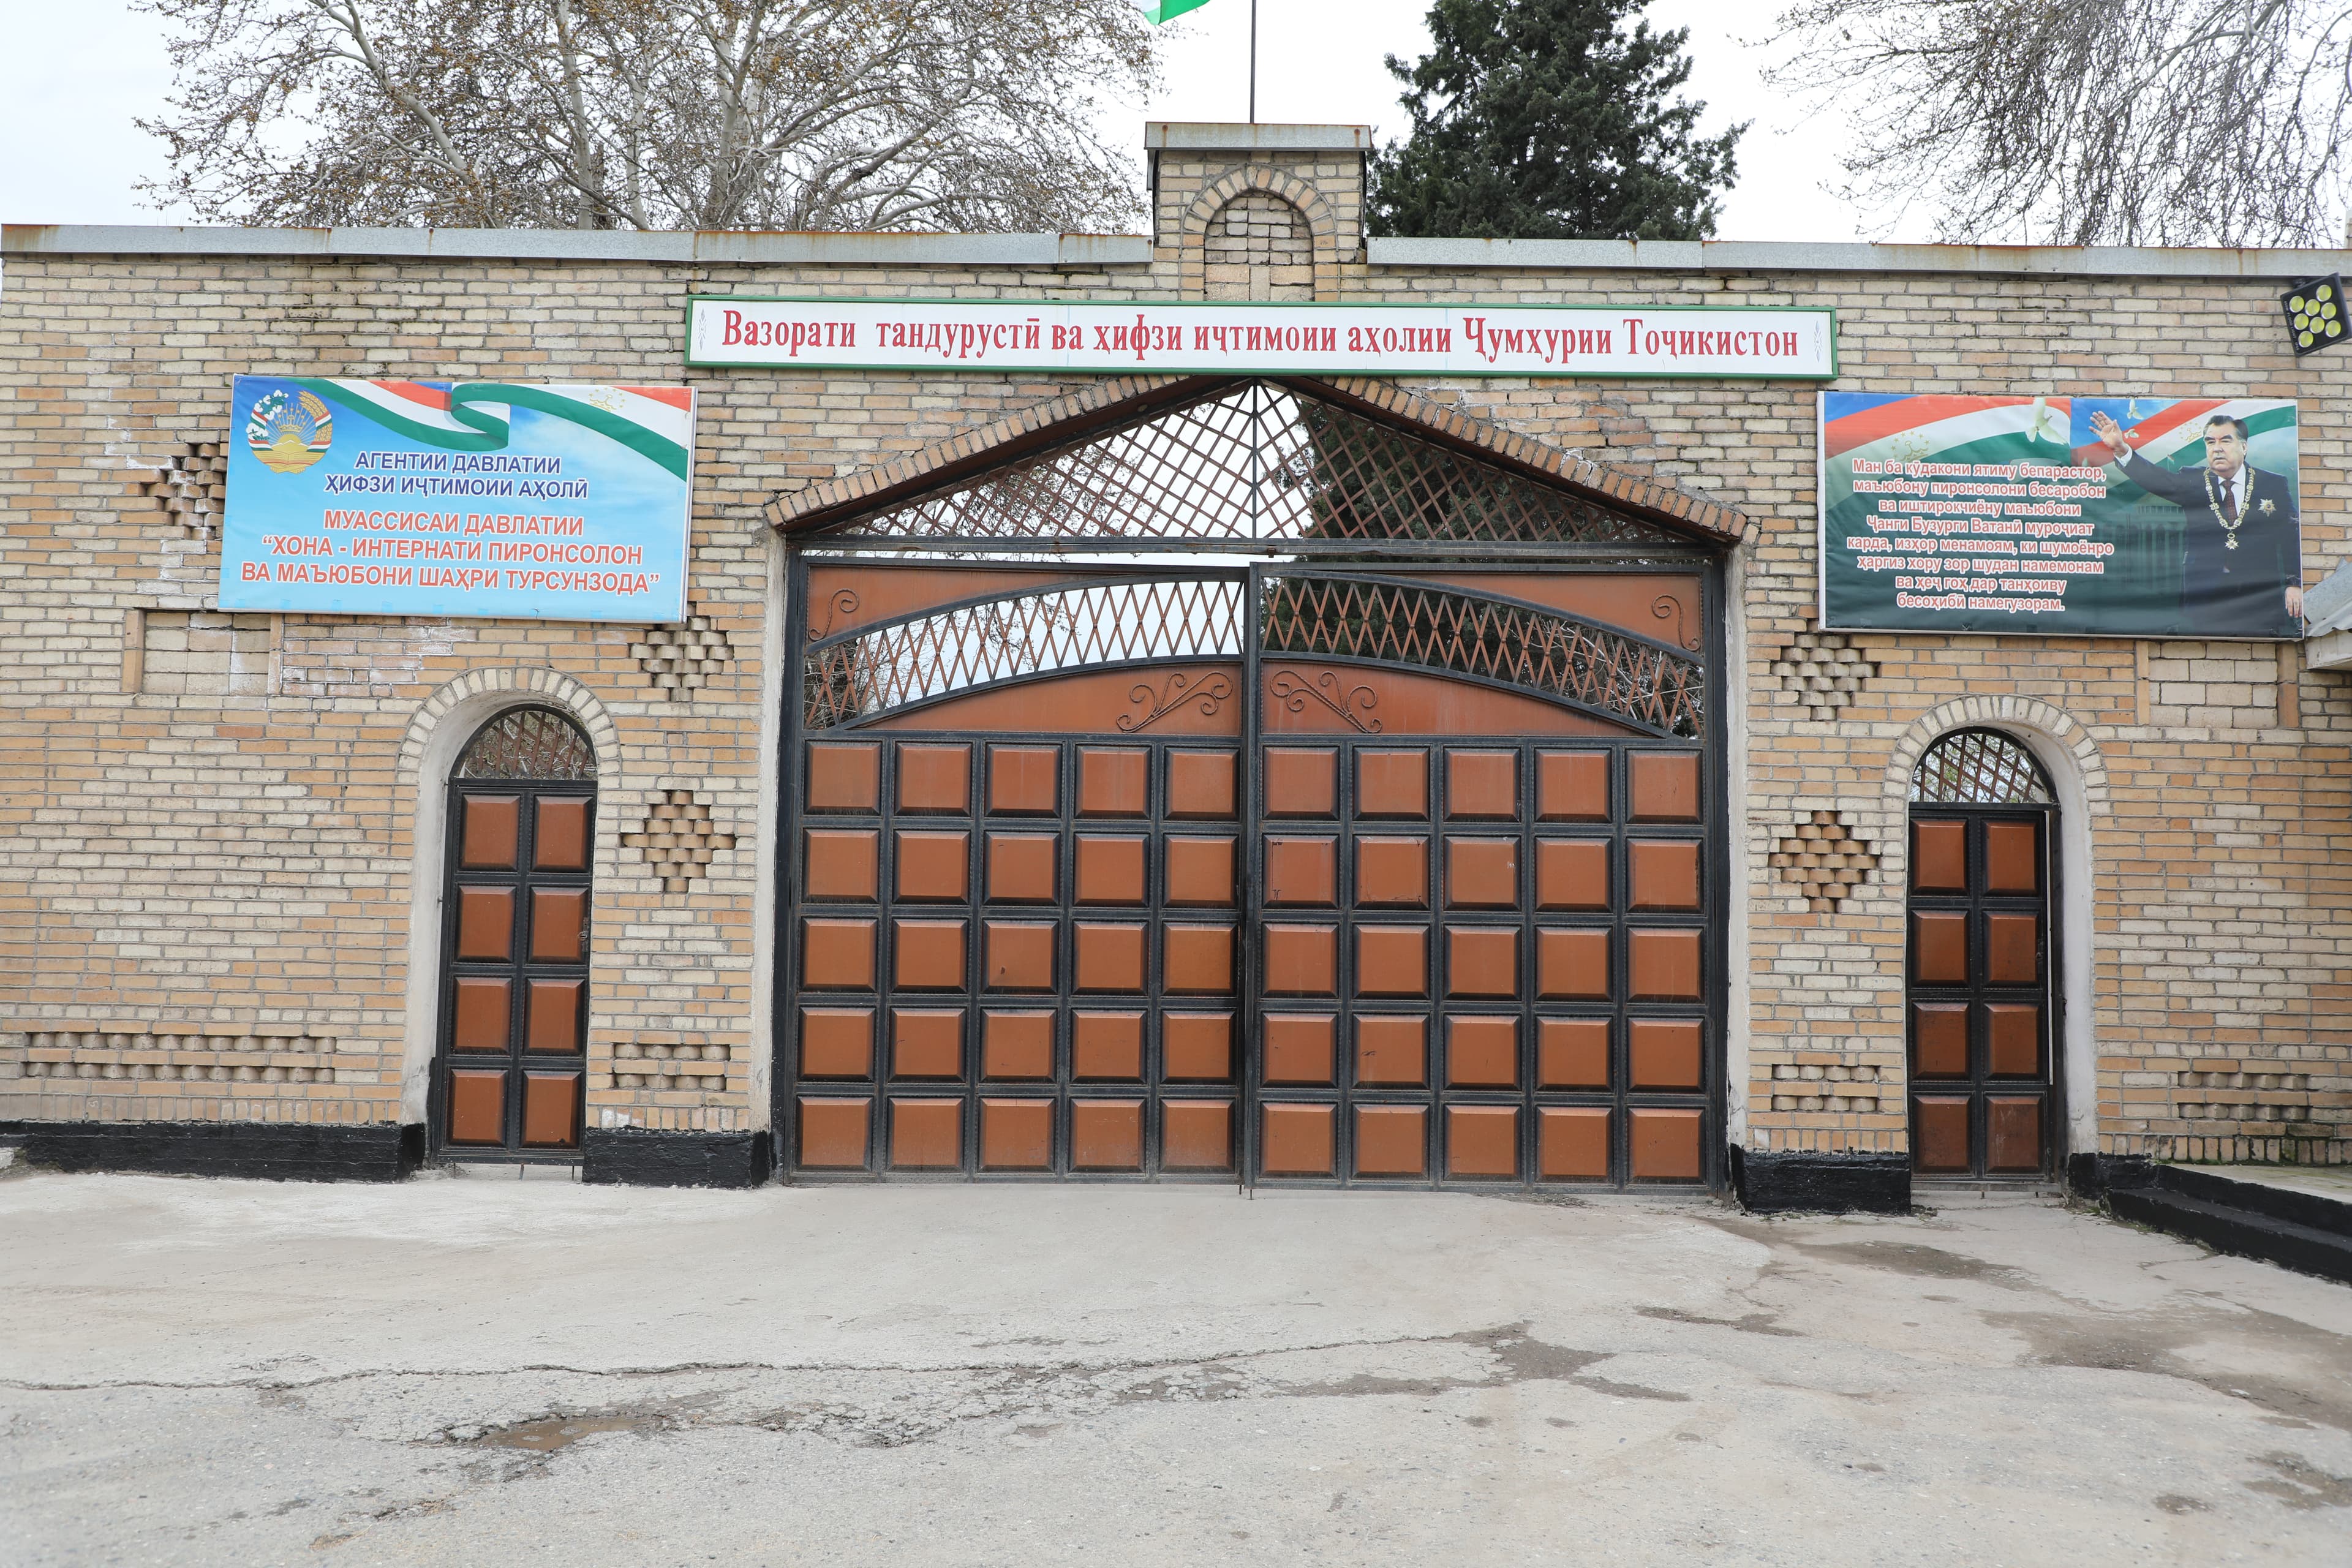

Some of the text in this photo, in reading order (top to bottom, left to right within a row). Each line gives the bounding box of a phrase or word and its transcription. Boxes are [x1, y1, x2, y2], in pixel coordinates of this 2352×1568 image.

[722, 310, 855, 357] Вазорати
[1052, 325, 1084, 350] ва
[356, 452, 560, 474] АГЕНТИИ ДАВЛАТИИ
[1853, 459, 2106, 481] Ман ба кӯдакони ятиму бепарастор,
[326, 475, 587, 500] ҲИФЗИ ИҶТИМОИИ АҲОЛӢ
[1853, 479, 2106, 499] маъюбону пиронсолони бесаробон
[1880, 500, 2081, 518] ва иштирокчиёну маъюбони
[325, 510, 582, 536] МУАССИСАИ ДАВЛАТИИ
[1913, 518, 1968, 537] Бузурги
[1972, 519, 2022, 534] Ватанӣ
[353, 538, 481, 560] ИНТЕРНАТИ
[489, 542, 642, 564] ПИРОНСОЛОН
[1848, 537, 1891, 551] карда,
[1940, 539, 2017, 554] менамоям,
[2021, 541, 2038, 552] ки
[2041, 540, 2114, 557] шумоёнро
[242, 562, 271, 581] ВА
[277, 564, 412, 585] МАЪЮБОНИ
[419, 568, 499, 590] ШАҲРИ
[1909, 558, 1941, 572] хору
[1945, 559, 1970, 572] зор
[1973, 560, 2019, 575] шудан
[2022, 561, 2103, 573] намемонам
[1897, 577, 1913, 588] ва
[1970, 578, 1997, 592] дар
[1969, 598, 2064, 612] намегузорам.
